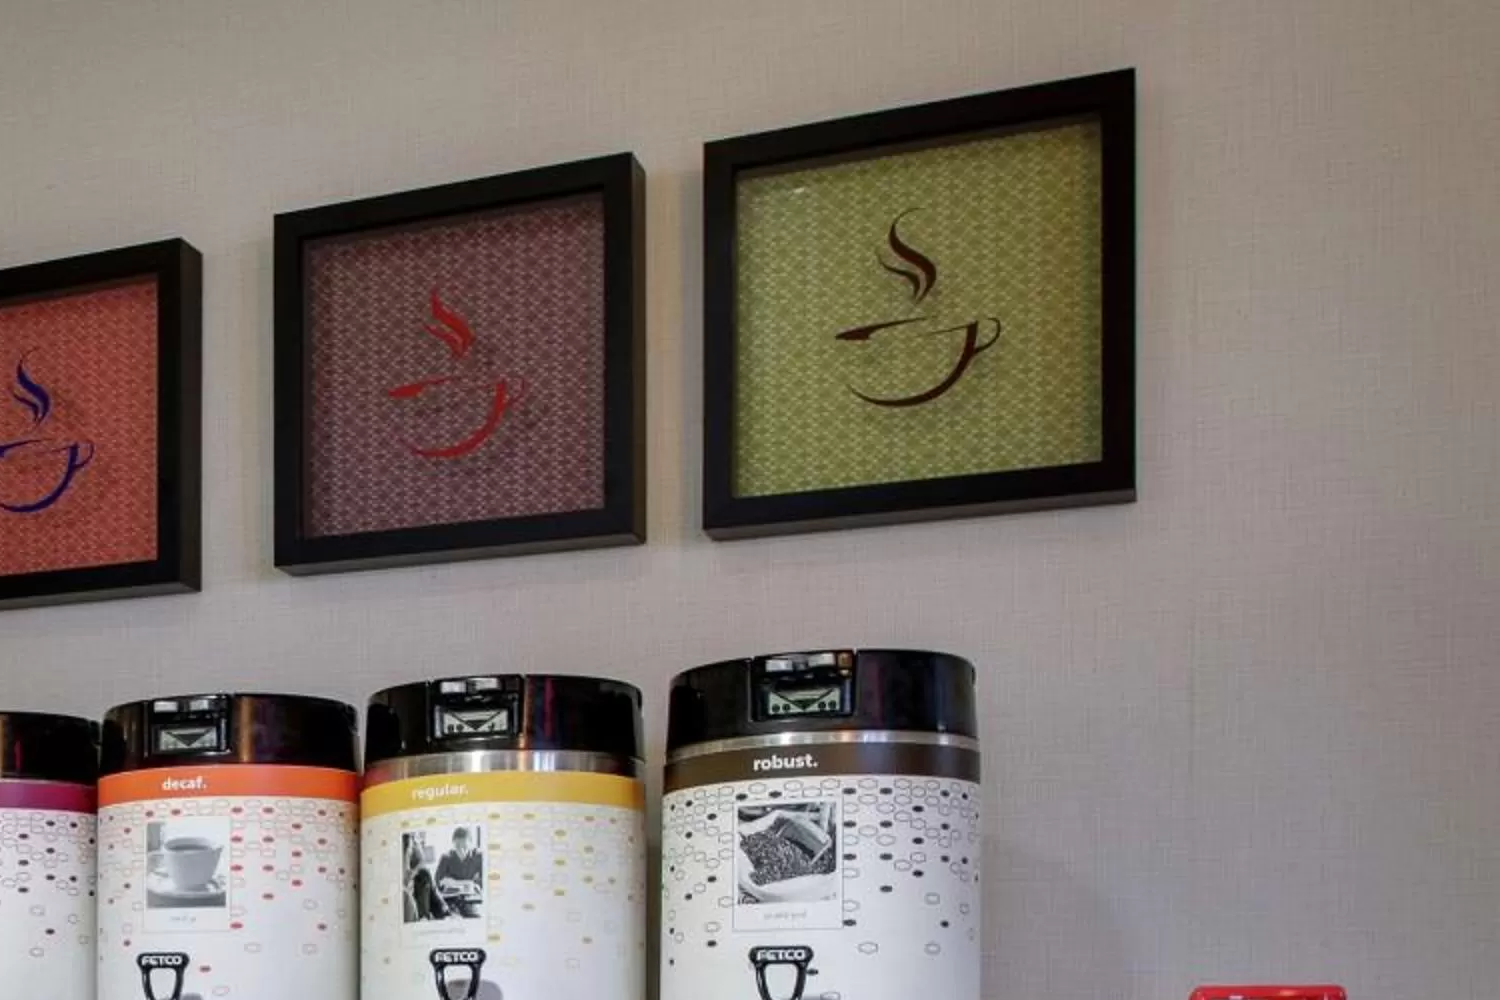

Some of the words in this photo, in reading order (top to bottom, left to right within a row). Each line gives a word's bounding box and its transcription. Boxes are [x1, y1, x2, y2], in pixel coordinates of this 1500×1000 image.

[753, 753, 818, 771] robust.
[162, 775, 207, 790] decaf.
[412, 783, 469, 801] regular.
[141, 955, 183, 966] FETCO
[435, 951, 479, 962] FETCO
[757, 949, 806, 960] FETCO
